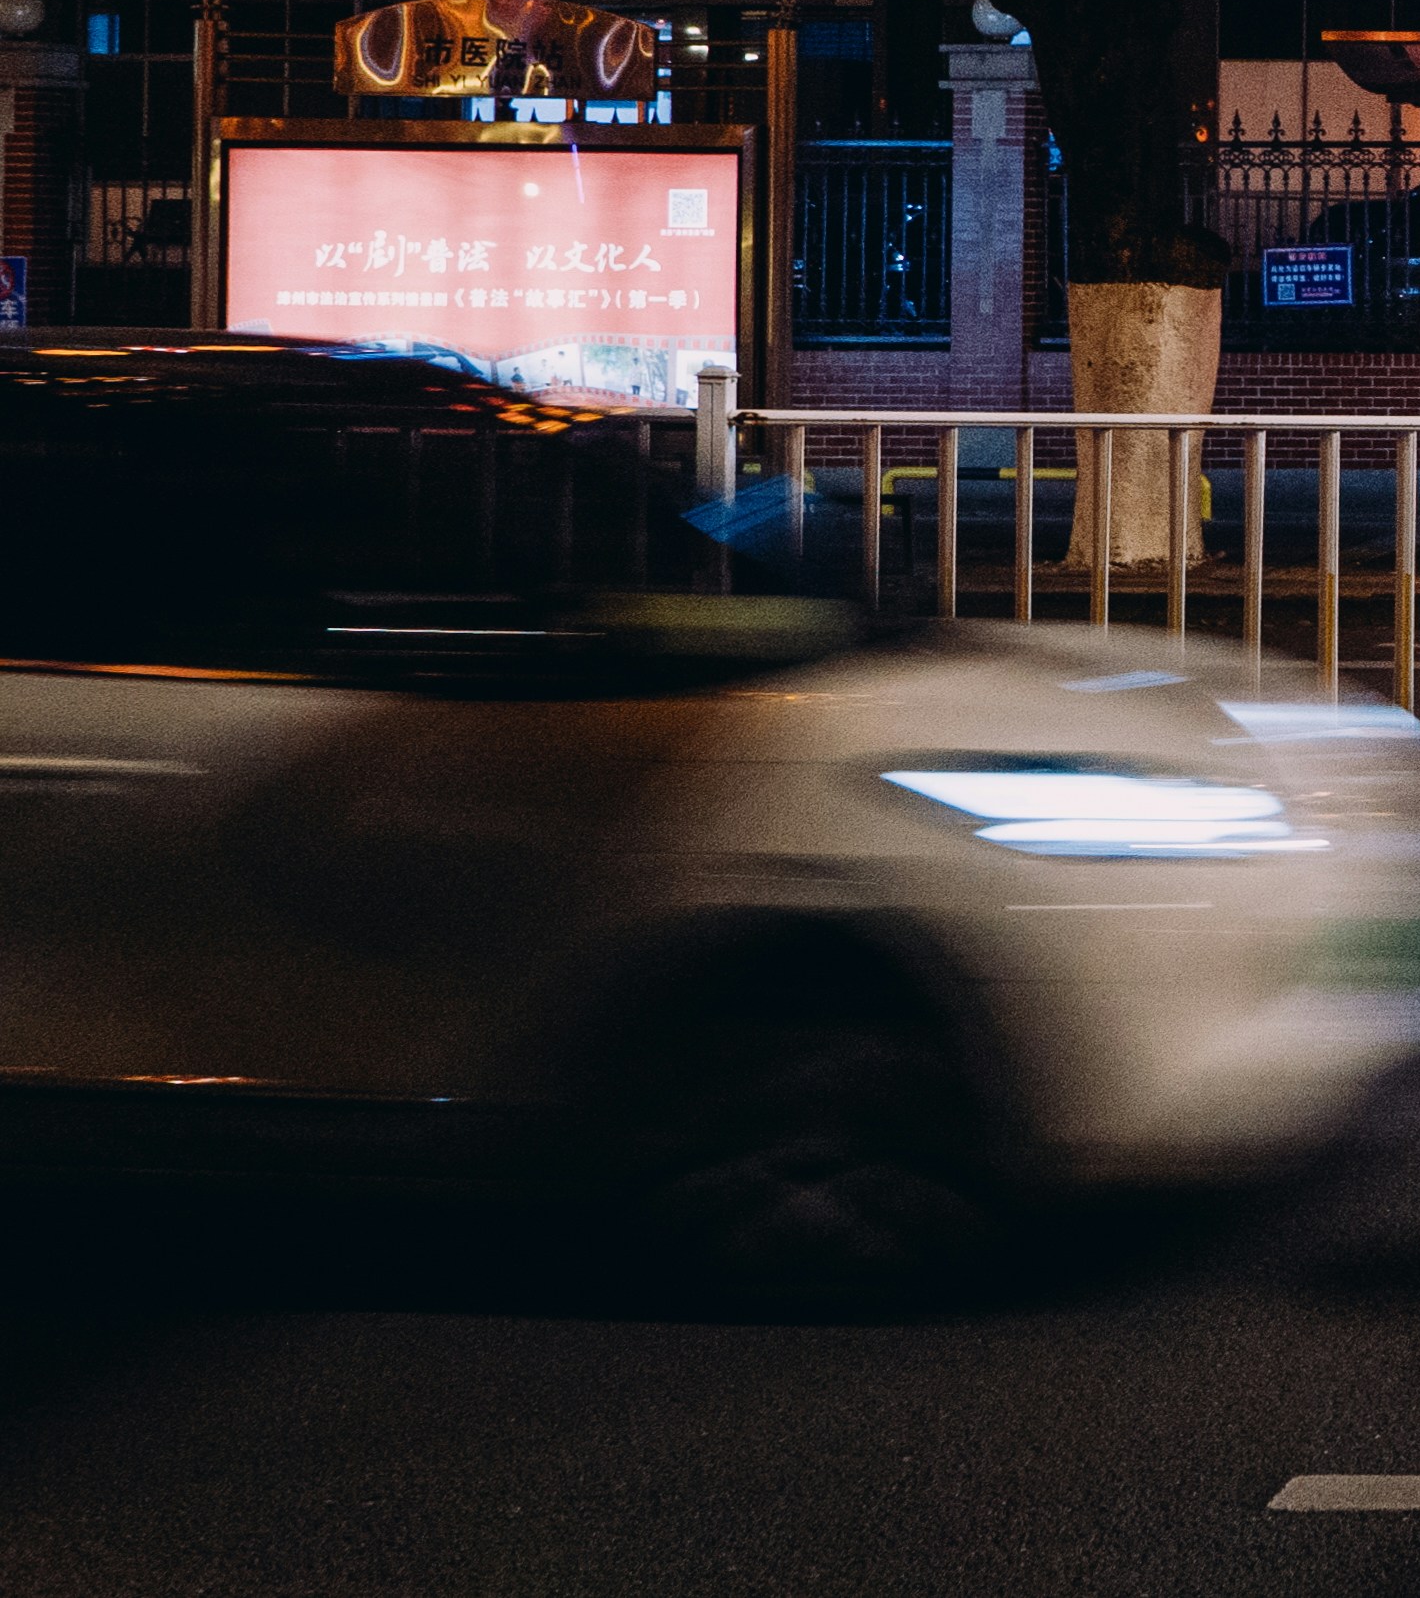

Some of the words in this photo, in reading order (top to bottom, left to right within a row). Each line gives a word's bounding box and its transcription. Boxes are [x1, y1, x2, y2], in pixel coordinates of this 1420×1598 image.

[423, 35, 565, 71] 市医院站
[525, 242, 662, 274] 以文化人
